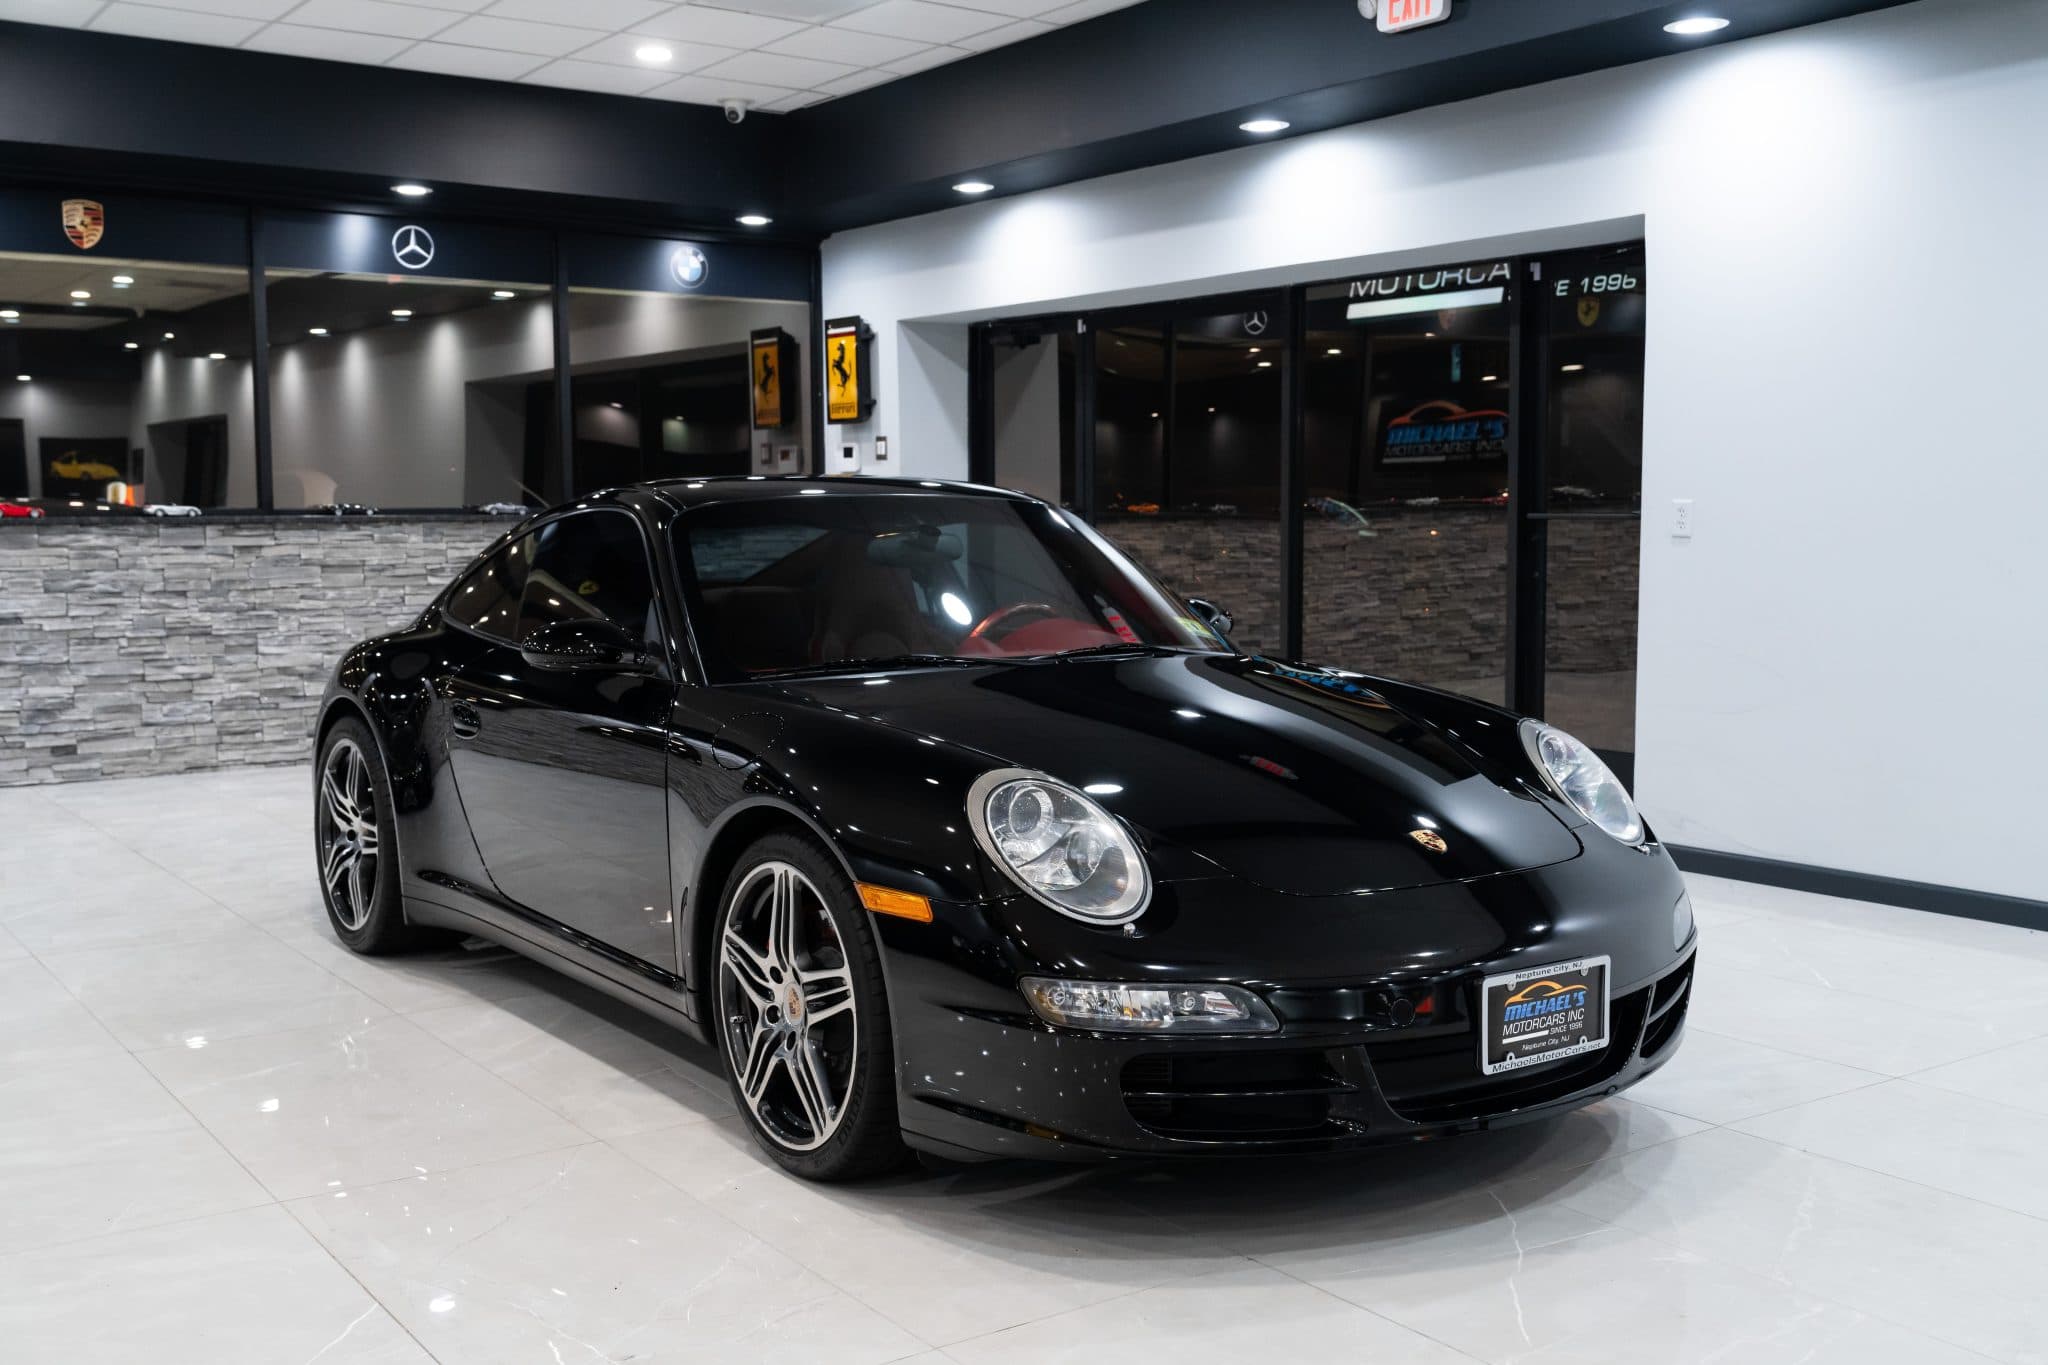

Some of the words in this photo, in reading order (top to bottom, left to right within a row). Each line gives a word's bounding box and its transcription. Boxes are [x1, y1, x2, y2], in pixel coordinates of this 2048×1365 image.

[1515, 968, 1552, 980] Neptune
[1503, 990, 1586, 1022] MICHAEL'S
[1502, 1012, 1566, 1037] MOTORCARS
[1567, 1007, 1585, 1023] INC
[1549, 1024, 1568, 1035] SINCE
